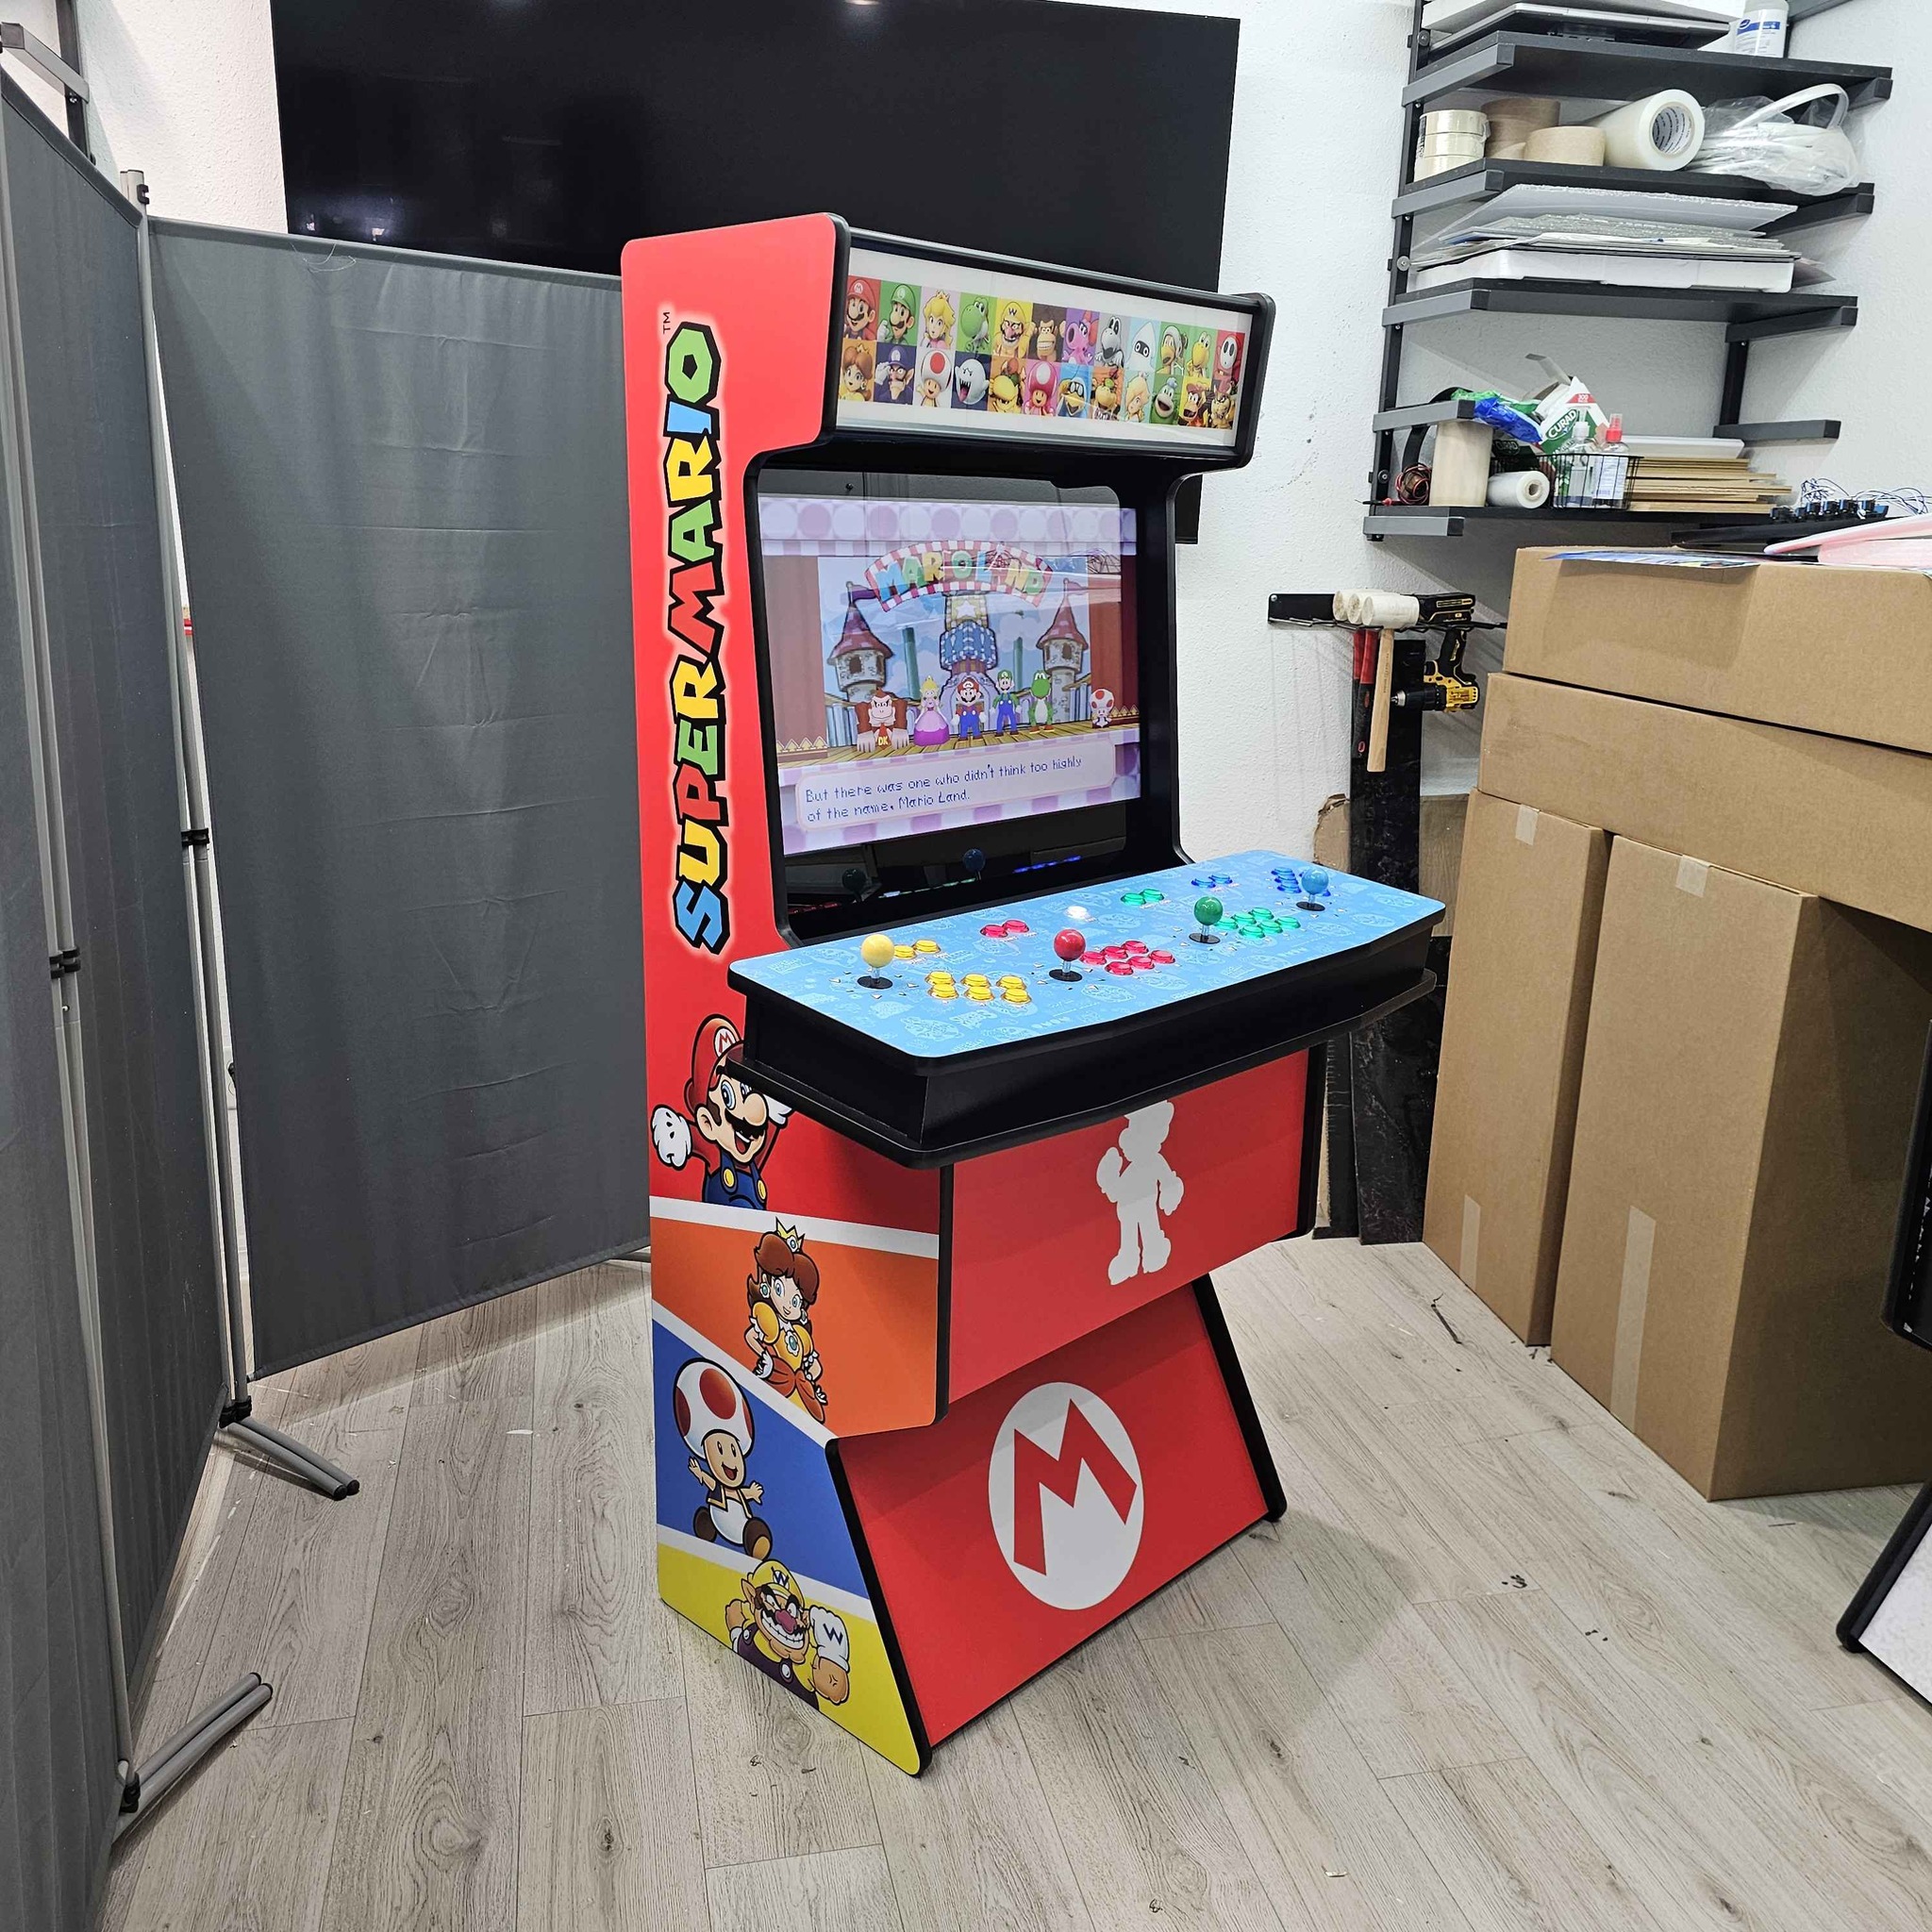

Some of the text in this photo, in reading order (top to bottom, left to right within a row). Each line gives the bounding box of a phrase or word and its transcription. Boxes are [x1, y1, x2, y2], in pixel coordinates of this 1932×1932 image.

[663, 312, 671, 335] TM
[1008, 308, 1017, 316] W
[1548, 409, 1576, 439] CURAD
[878, 736, 889, 746] DK
[806, 756, 1082, 803] But there was one who didn't think too highly
[807, 808, 821, 822] of
[826, 807, 849, 820] the
[898, 794, 934, 809] Mario
[938, 789, 970, 804] Land.
[1013, 1398, 1138, 1576] M
[771, 1566, 790, 1586] W
[823, 1623, 844, 1646] W
